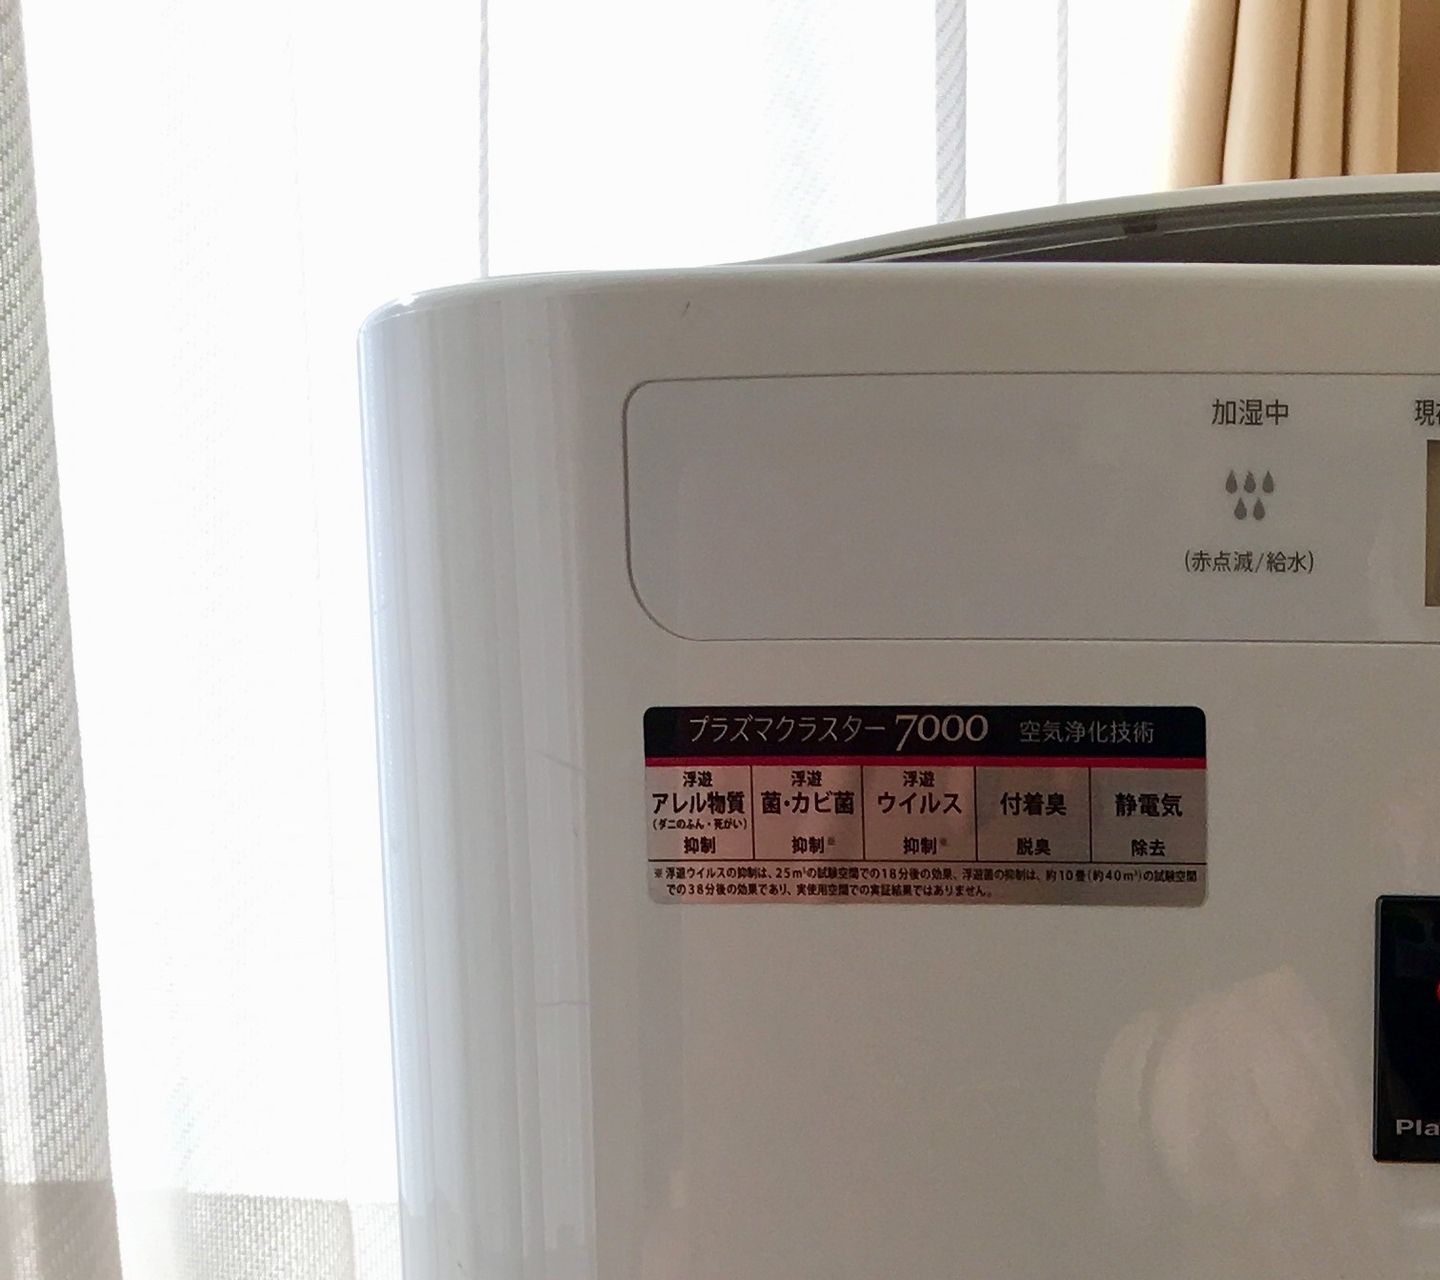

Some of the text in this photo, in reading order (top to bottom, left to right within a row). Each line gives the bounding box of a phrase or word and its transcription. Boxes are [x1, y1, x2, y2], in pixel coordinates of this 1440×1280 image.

[1211, 399, 1290, 427] 加湿中
[688, 714, 1155, 752] プラズマクラスター 7000 空気浄化技術
[682, 771, 713, 788] 浮遊
[791, 771, 822, 788] 浮遊
[903, 771, 935, 788] 浮遊
[651, 793, 745, 815] アレル物質
[877, 792, 963, 816] ウイルス
[1000, 792, 1067, 816] 付着臭
[1115, 793, 1183, 817] 静電気
[683, 836, 716, 855] 抑制
[1016, 838, 1051, 856] 脱臭
[1131, 839, 1166, 857] 除去
